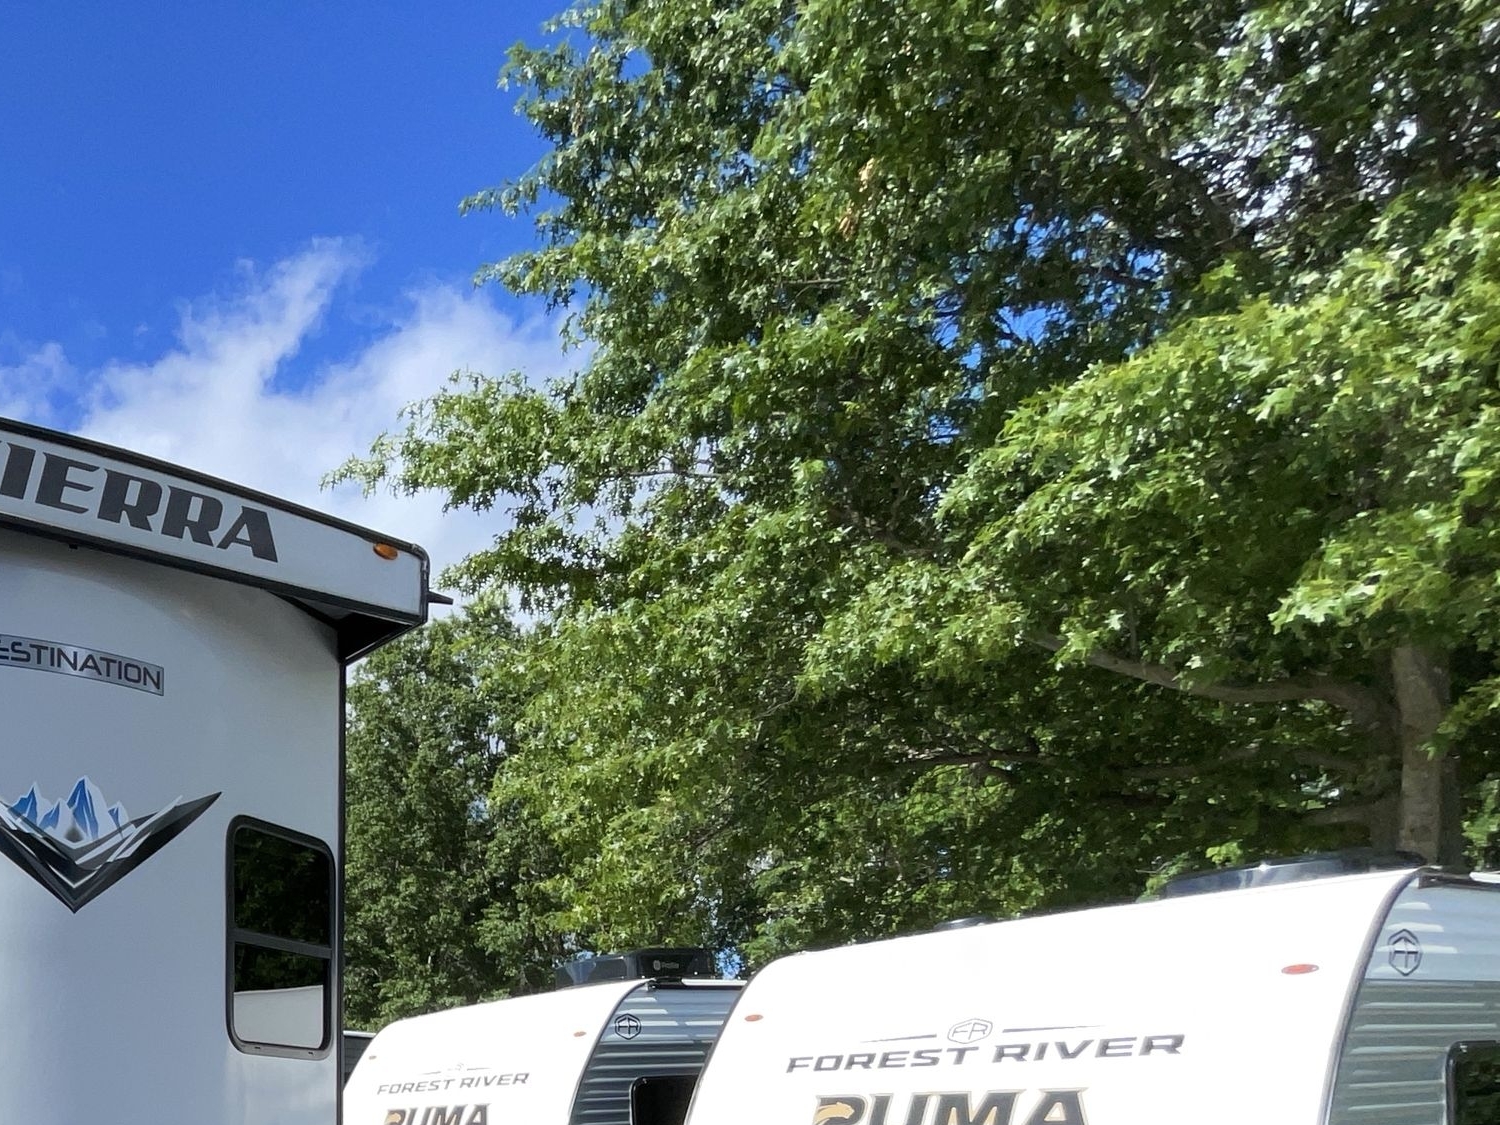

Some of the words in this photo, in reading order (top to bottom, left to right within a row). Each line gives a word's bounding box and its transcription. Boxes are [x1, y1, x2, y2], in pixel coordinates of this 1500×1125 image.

[786, 1046, 980, 1073] FOREST
[992, 1033, 1185, 1063] RIVER
[377, 1078, 456, 1095] FOREST
[459, 1072, 530, 1089] RIVER
